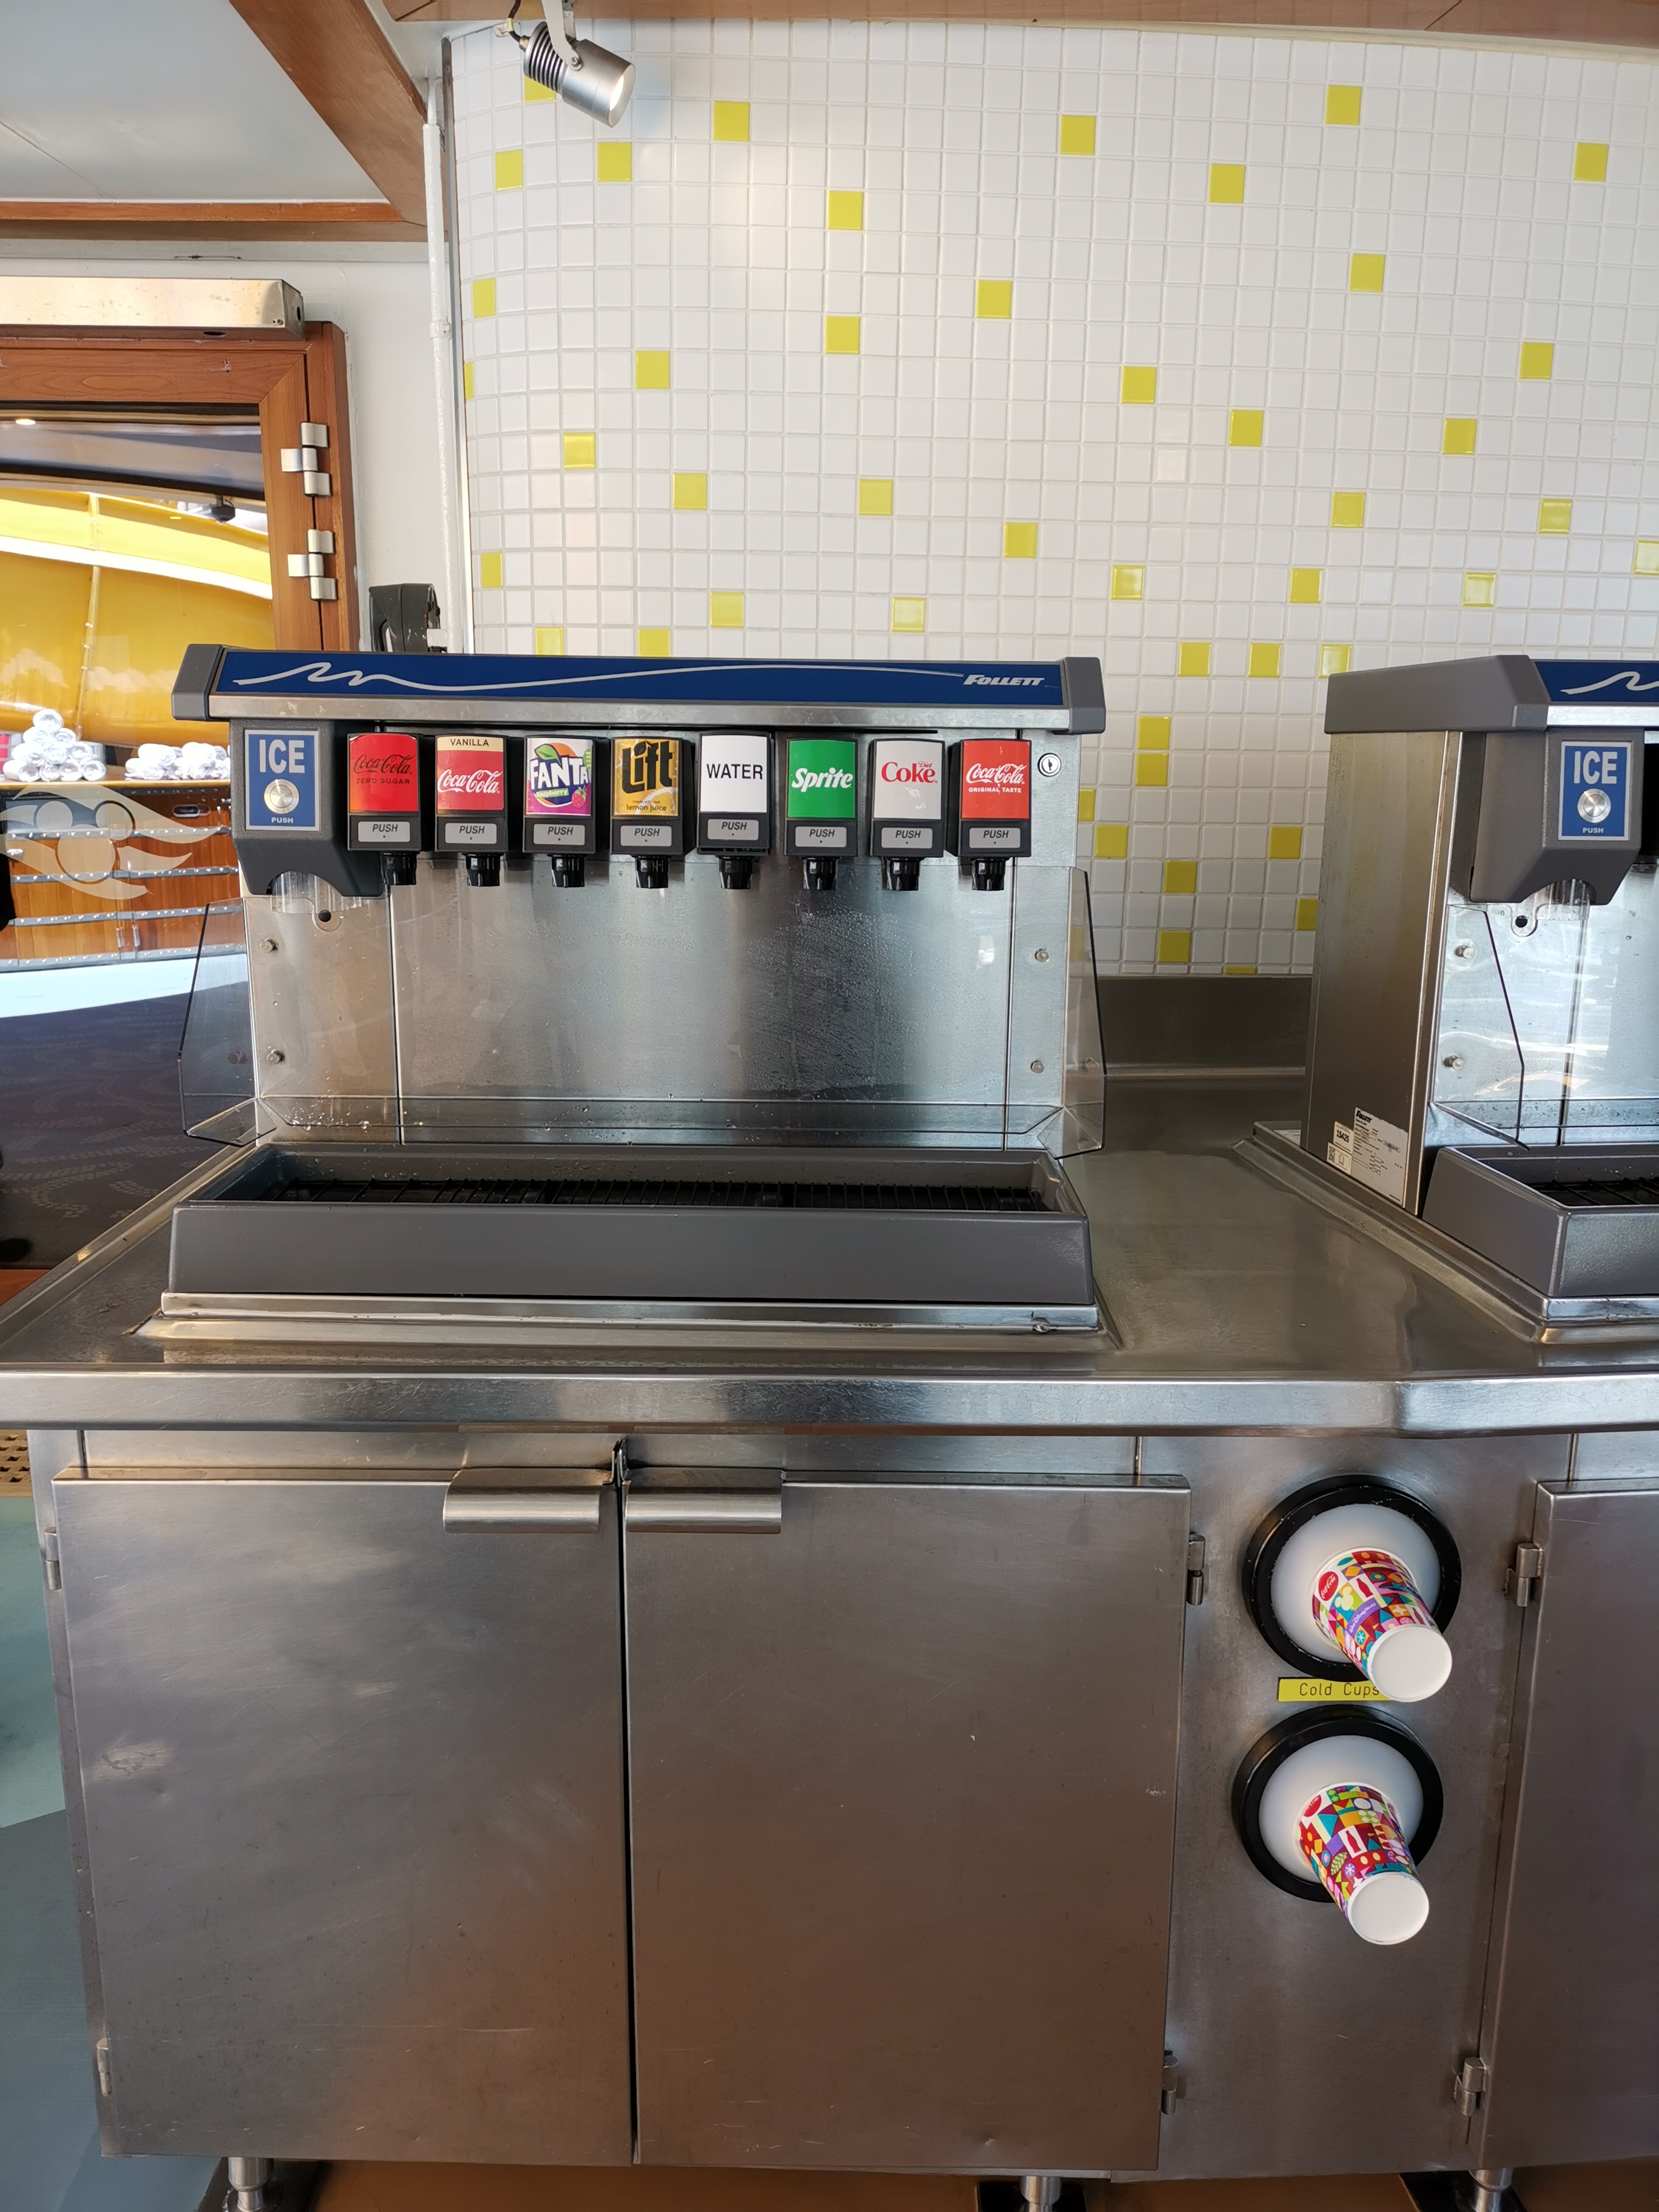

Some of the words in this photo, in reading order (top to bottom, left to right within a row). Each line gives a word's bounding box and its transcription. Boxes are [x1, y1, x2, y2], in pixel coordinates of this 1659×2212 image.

[963, 674, 1045, 686] FOLLETT
[450, 738, 489, 746] VANILLA
[259, 739, 305, 774] ICE
[354, 754, 415, 774] Coca-Cola
[622, 740, 672, 794] Lift
[1574, 751, 1617, 784] ICE
[530, 757, 589, 790] FANTA
[706, 763, 763, 780] WATER
[881, 762, 936, 783] Coke
[966, 763, 1027, 784] Coca-Cola
[437, 769, 503, 793] Coca-Cola
[791, 767, 853, 792] Sprite
[536, 789, 568, 797] Raspberry
[649, 804, 666, 813] juice
[372, 823, 398, 833] PUSH
[459, 825, 484, 834] PUSH
[548, 826, 573, 836] PUSH
[634, 828, 660, 837] PUSH
[722, 822, 747, 831] PUSH
[809, 829, 835, 838] PUSH
[895, 830, 921, 839] PUSH
[983, 830, 1009, 839] PUSH
[1299, 1683, 1332, 1696] Cold
[1344, 1683, 1379, 1698] Cups
